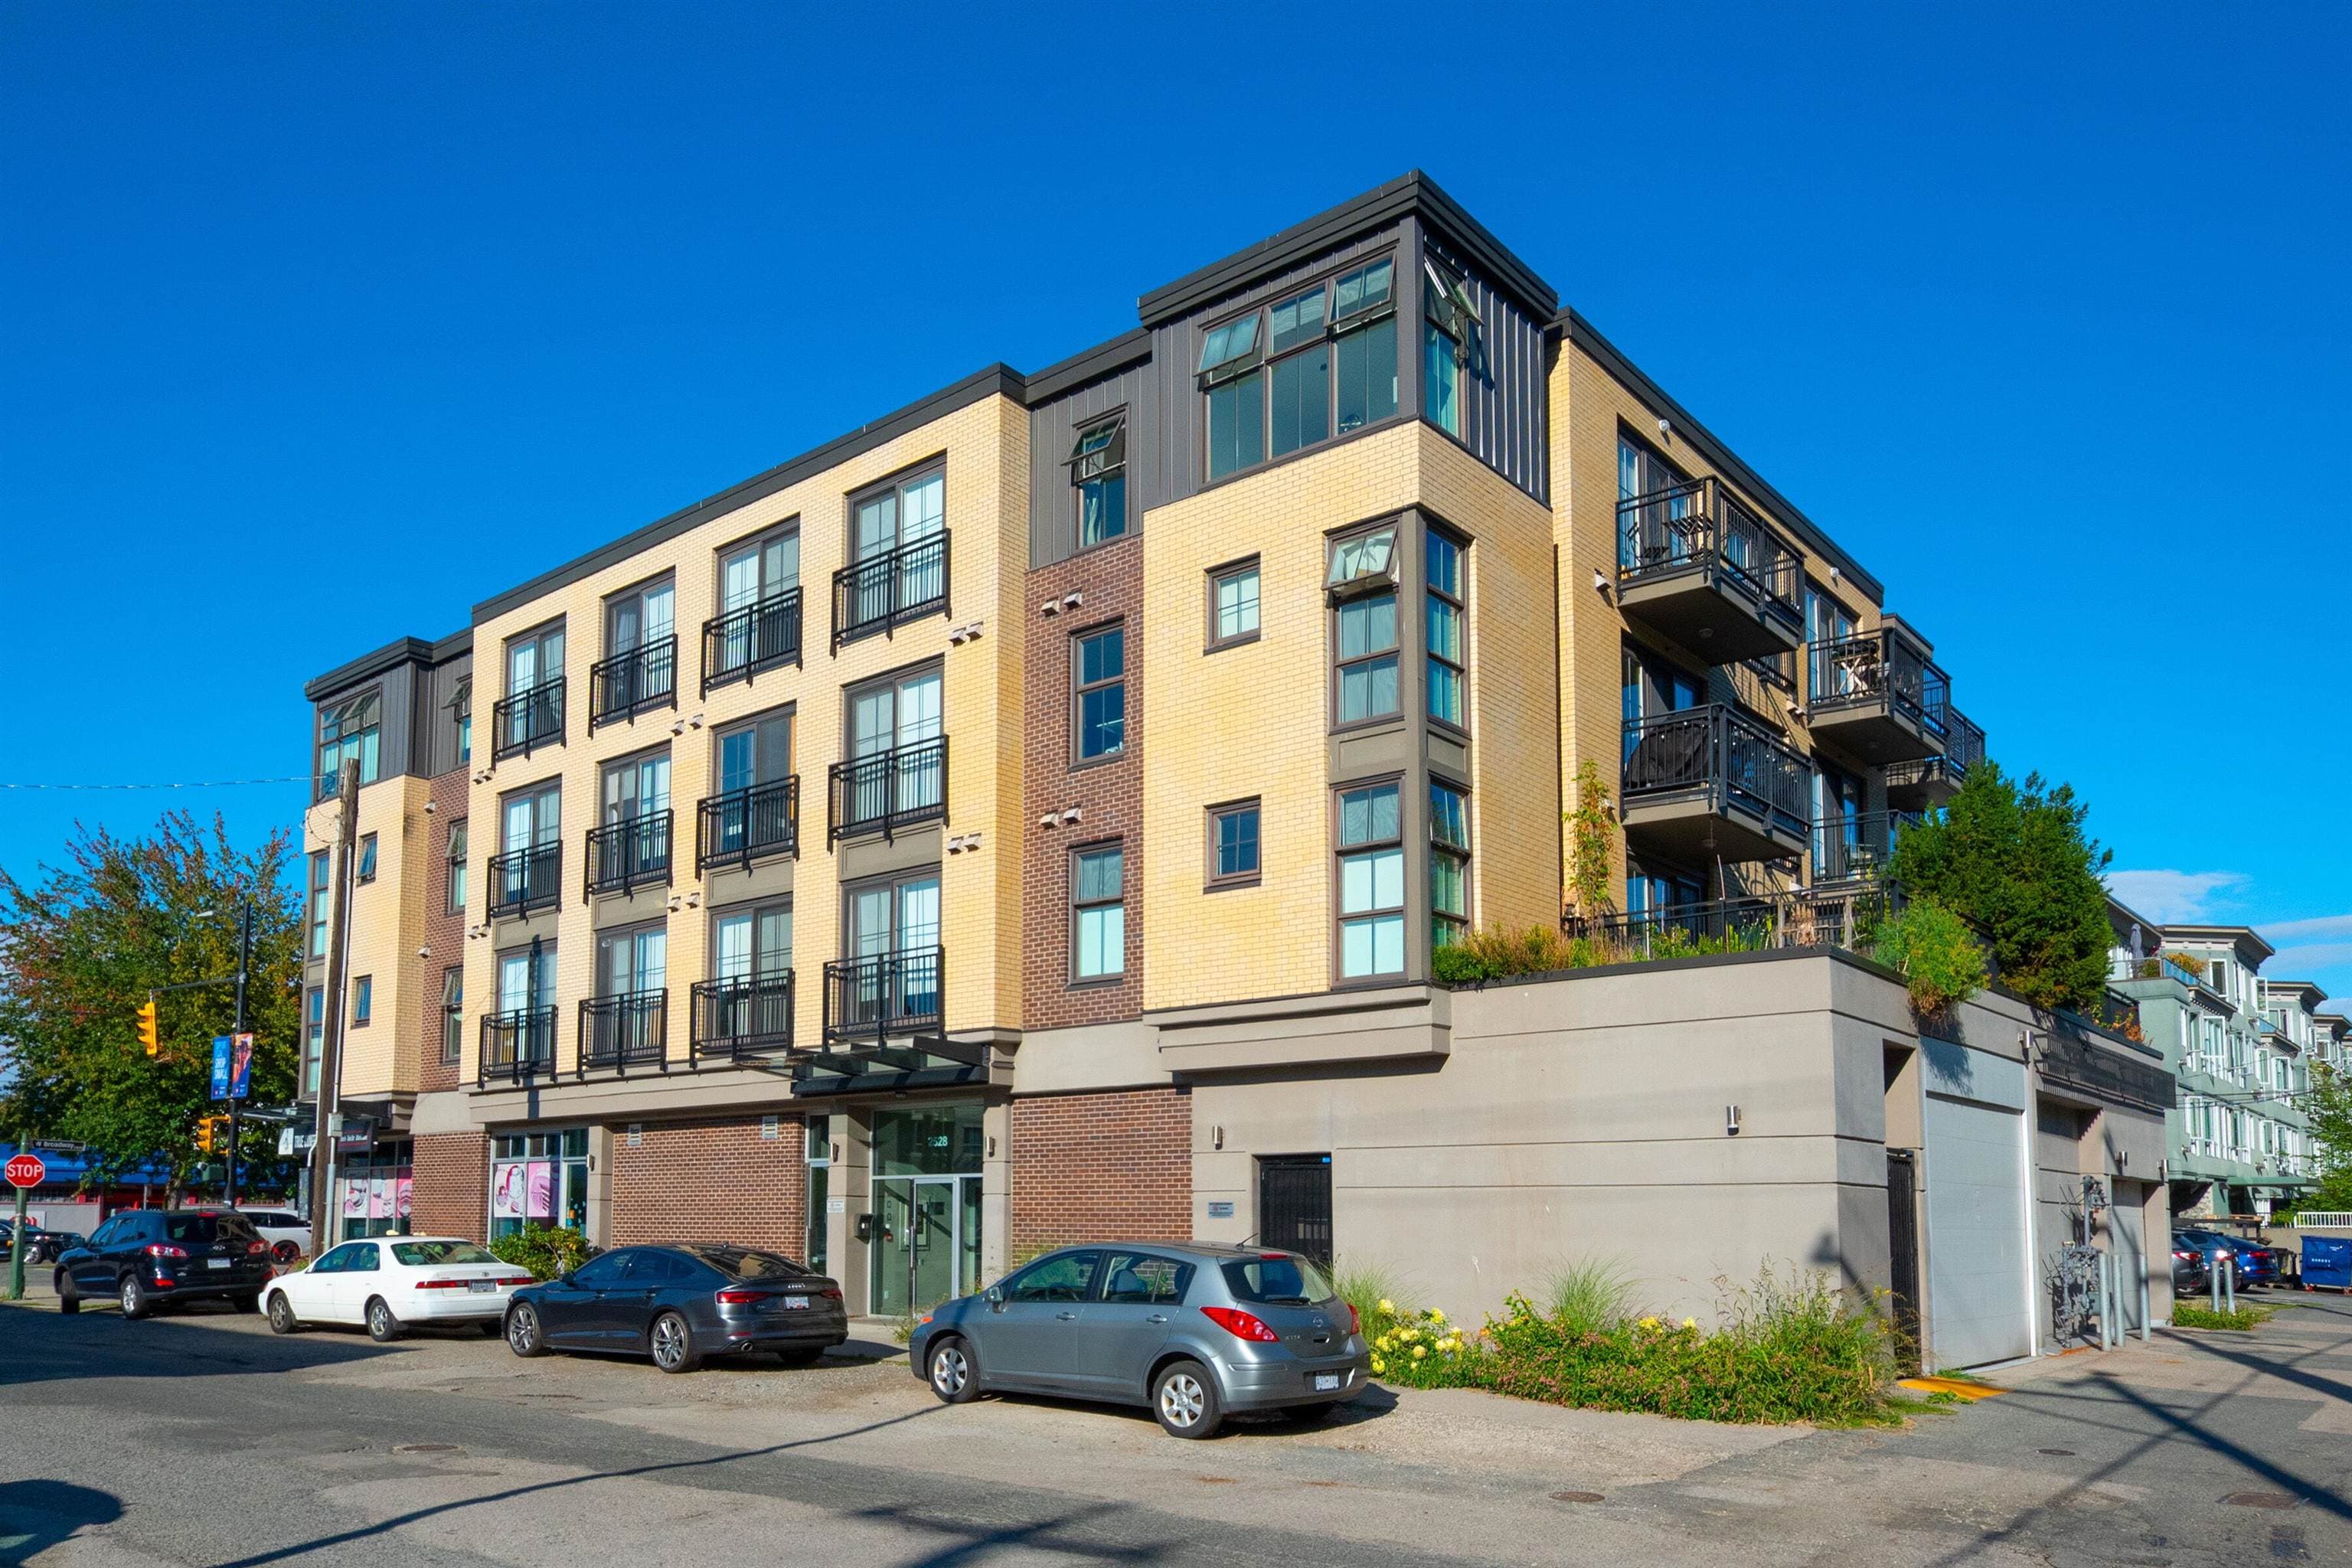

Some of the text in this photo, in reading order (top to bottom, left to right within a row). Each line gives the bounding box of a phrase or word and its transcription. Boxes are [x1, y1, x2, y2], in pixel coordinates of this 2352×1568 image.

[44, 1141, 74, 1149] Broadway
[927, 1136, 948, 1147] 2528
[7, 1164, 43, 1178] STOP
